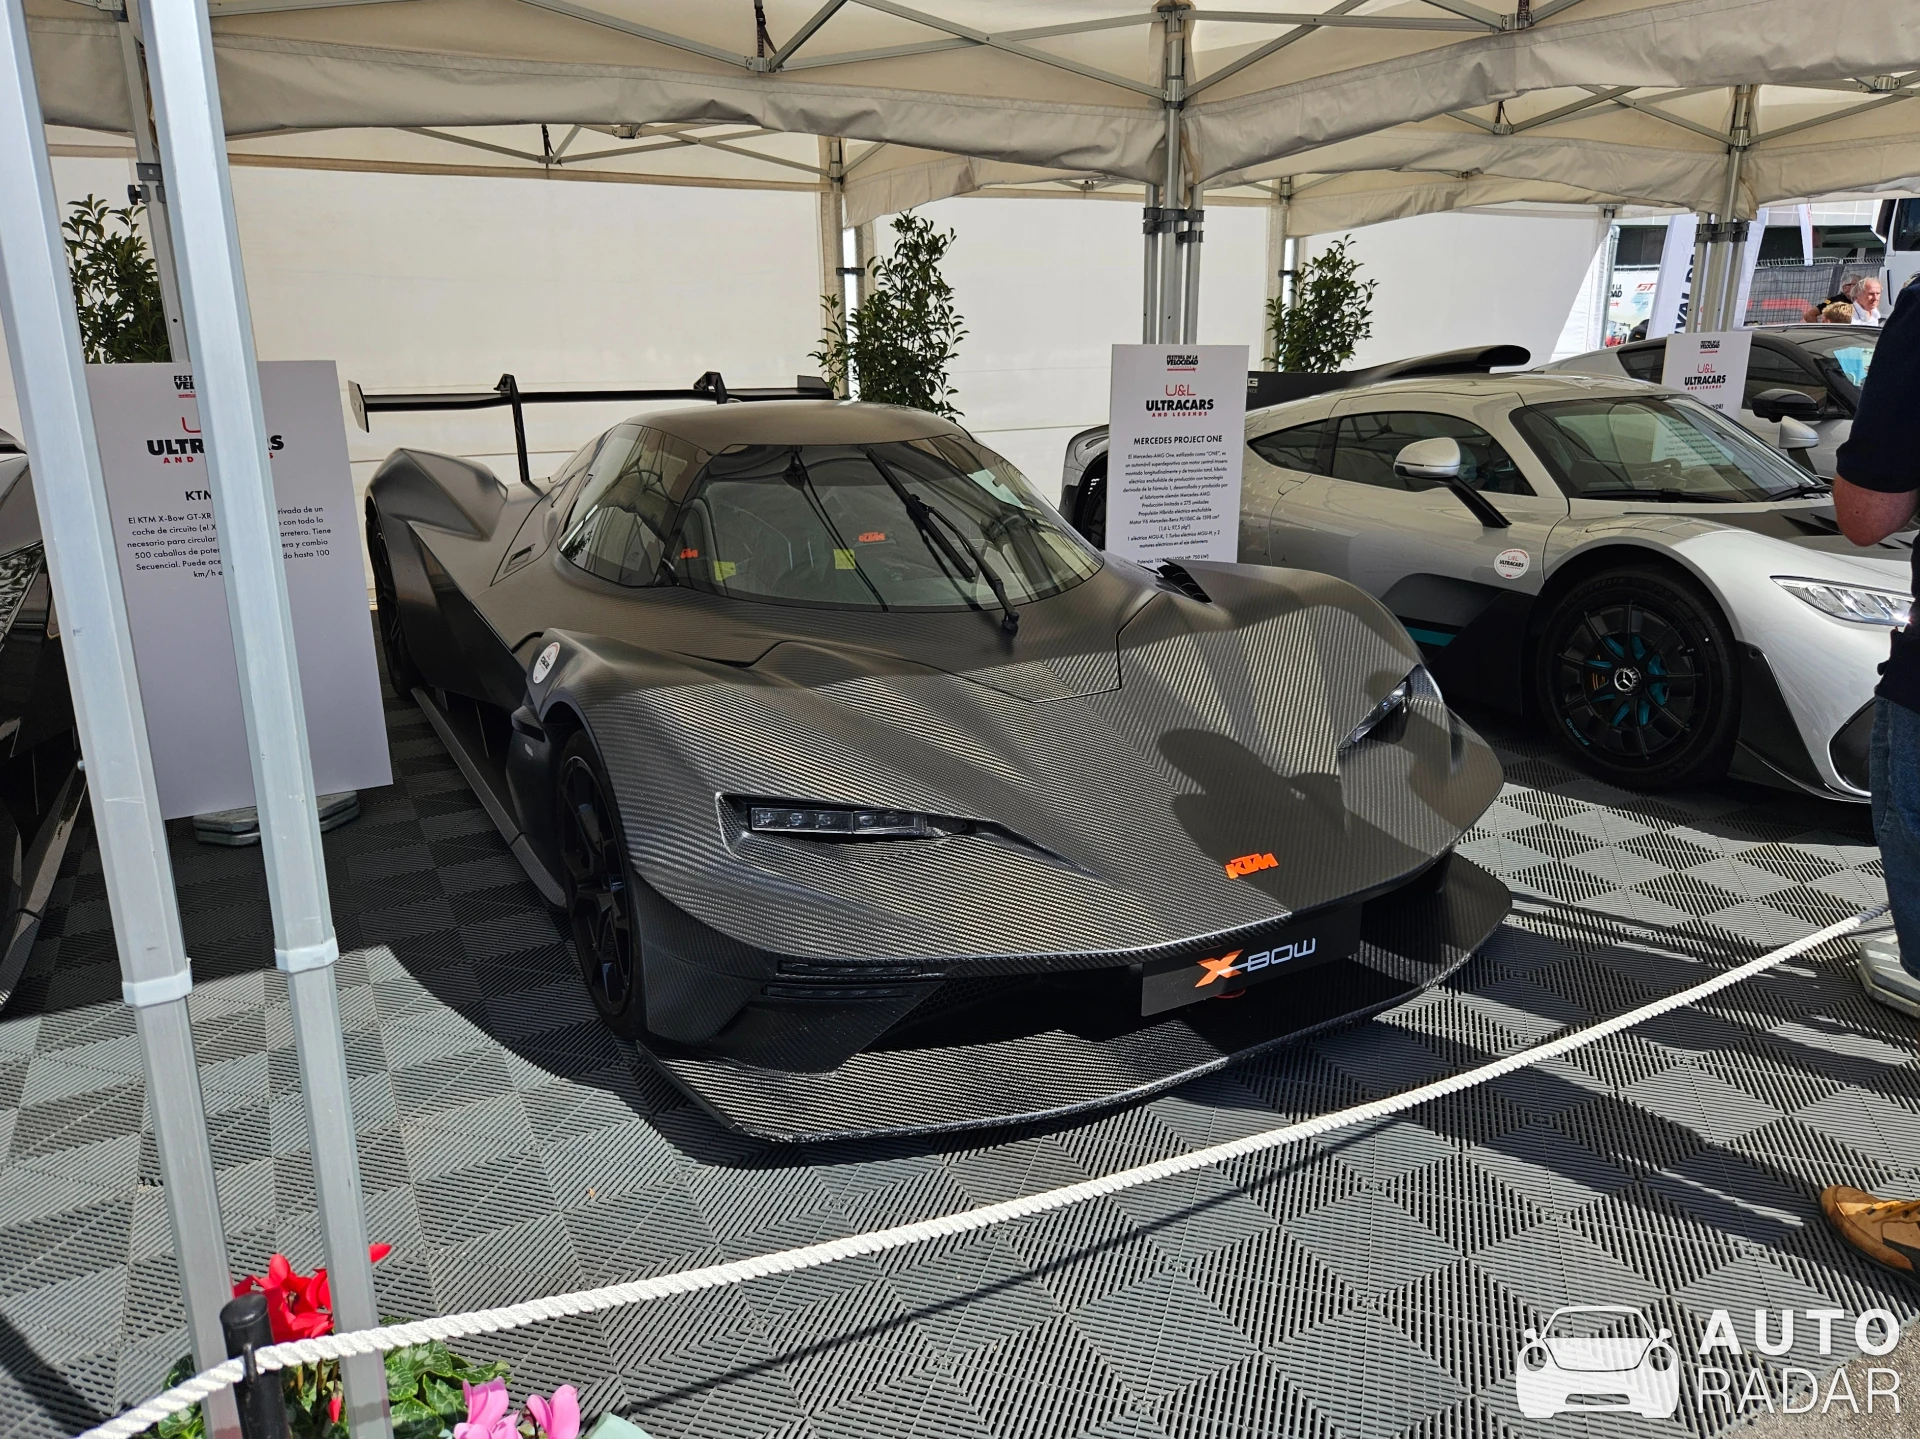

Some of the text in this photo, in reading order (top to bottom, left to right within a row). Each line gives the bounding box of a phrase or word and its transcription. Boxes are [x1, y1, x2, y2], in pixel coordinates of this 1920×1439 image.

[1684, 374, 1726, 386] ULTRACARS
[1165, 384, 1196, 396] U&L
[1146, 399, 1214, 412] ULTRACARS
[1134, 436, 1172, 446] MERCEDES
[1174, 436, 1206, 444] PROJECT
[138, 516, 157, 524] KTM
[158, 514, 184, 522] X-Bow
[186, 512, 212, 521] GT-XR
[132, 528, 155, 536] coche
[157, 526, 167, 535] de
[170, 525, 198, 534] circuito
[199, 524, 210, 533] (el
[298, 516, 315, 525] todo
[126, 540, 165, 548] necesario
[167, 539, 186, 548] para
[188, 536, 216, 544] circular
[134, 552, 152, 560] 500
[154, 549, 187, 558] caballos
[188, 548, 198, 556] de
[302, 538, 328, 547] cambio
[136, 562, 181, 572] Secuencial.
[182, 558, 206, 568] Puede
[294, 551, 314, 559] hasta
[316, 549, 330, 557] 100
[193, 570, 216, 579] km/h
[1224, 852, 1279, 880] KTM
[1194, 938, 1316, 988] X-BOW
